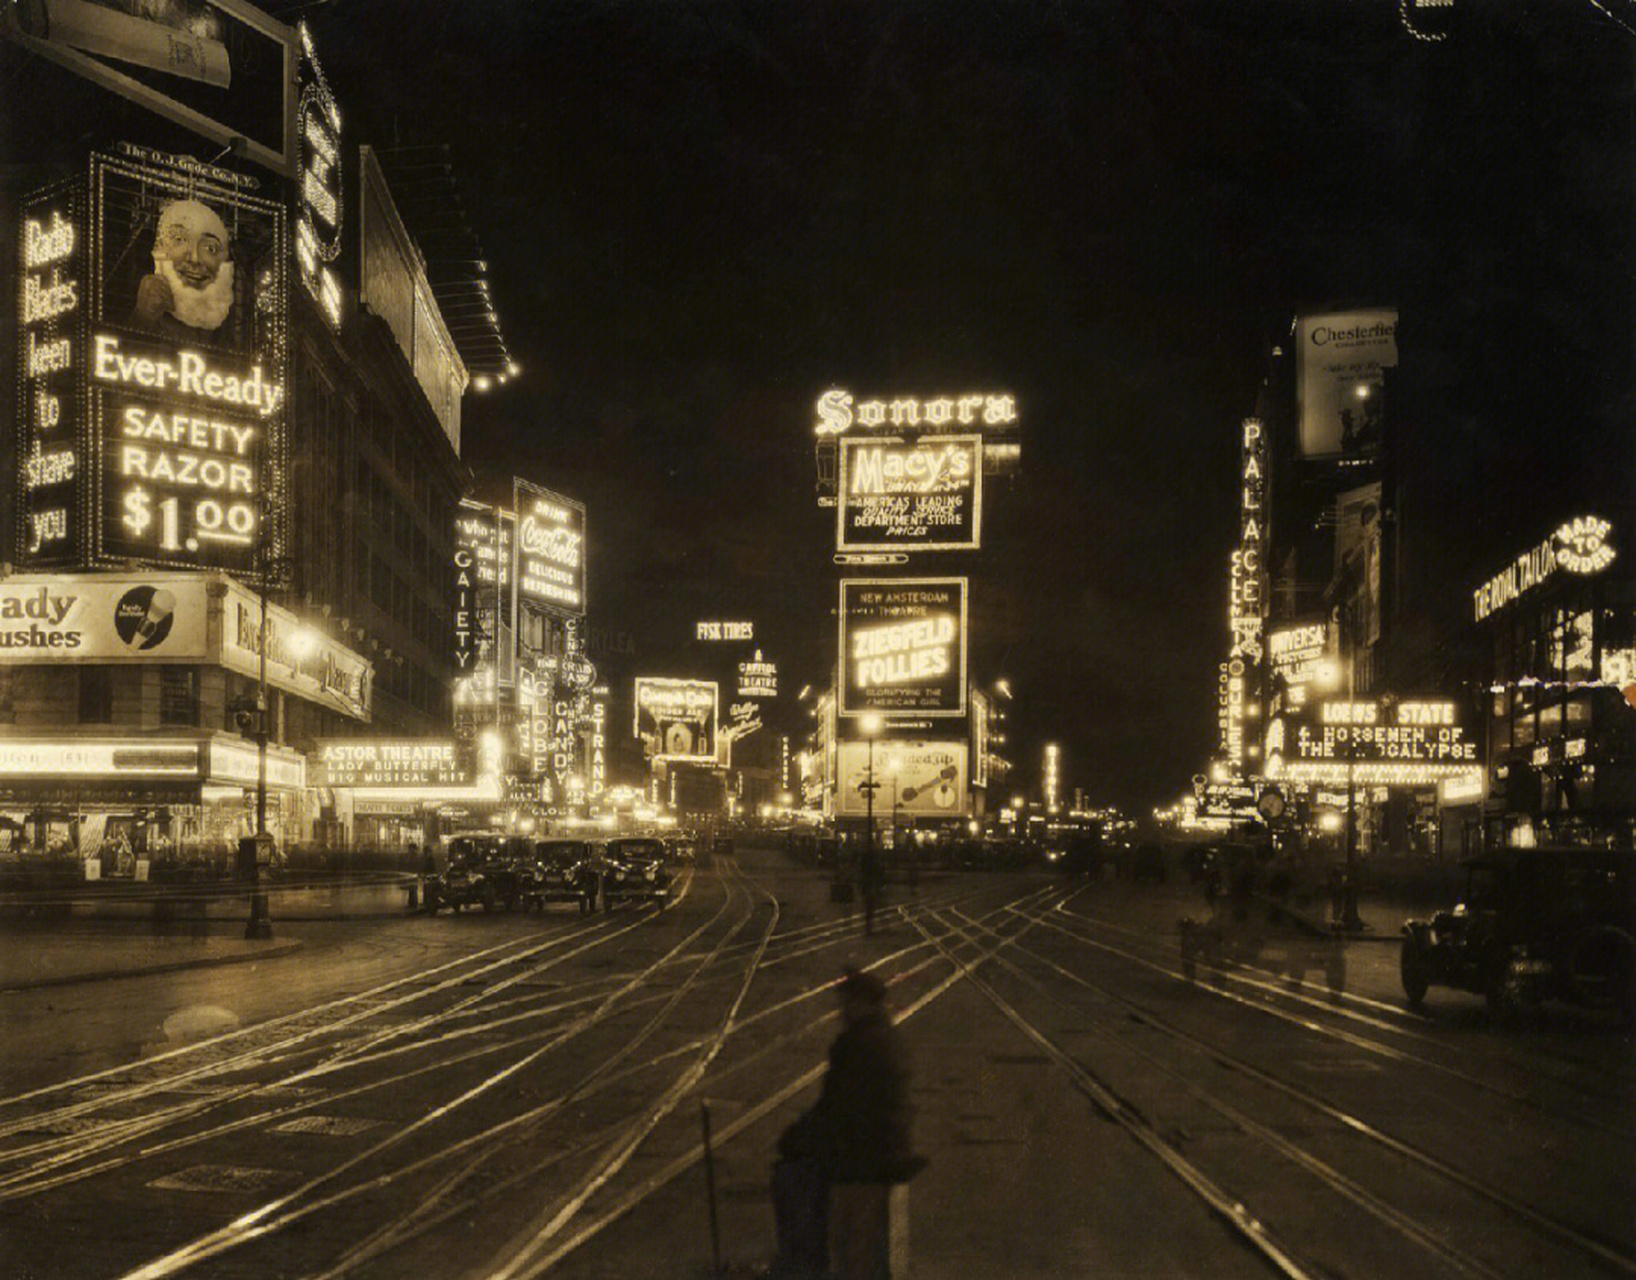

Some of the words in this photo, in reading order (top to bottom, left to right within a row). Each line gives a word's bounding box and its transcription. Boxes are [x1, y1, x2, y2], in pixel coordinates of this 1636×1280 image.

[124, 142, 146, 159] The
[94, 334, 285, 416] Ever-Ready
[815, 390, 1017, 434] Sonora
[123, 407, 254, 454] SAFETY
[123, 445, 252, 493] RAZOR
[852, 445, 969, 493] Macy's
[915, 495, 963, 507] LEADING
[1243, 423, 1260, 602] PALACE
[30, 508, 67, 553] you
[854, 514, 923, 527] DEPARTMENT
[926, 513, 963, 526] STORE
[885, 526, 929, 536] PRICES
[2, 586, 78, 626] ady
[454, 550, 473, 668] GAIETY
[860, 592, 882, 604] NEW
[886, 591, 949, 603] AMSTERDAM
[696, 622, 721, 640] FISK
[723, 622, 754, 640] TIRES
[852, 616, 955, 659] ZIEGFELD
[857, 646, 948, 688] FOLLIES
[865, 688, 921, 697] GLORIFYING
[925, 688, 942, 697] THE
[865, 698, 916, 706] AMERICAN
[533, 680, 549, 773] GLOBE
[1397, 702, 1455, 724] STATE
[554, 700, 569, 786] CANDY
[592, 702, 605, 795] STRAND
[1298, 742, 1335, 757] THE
[1438, 727, 1463, 743] OF
[324, 745, 377, 761] ASTOR
[380, 745, 454, 761] THEATRE
[327, 760, 364, 772] LADY
[374, 760, 457, 772] BUTTERFLY
[327, 772, 354, 783] BIG
[364, 772, 429, 783] MUSICAL
[438, 772, 466, 783] HIT
